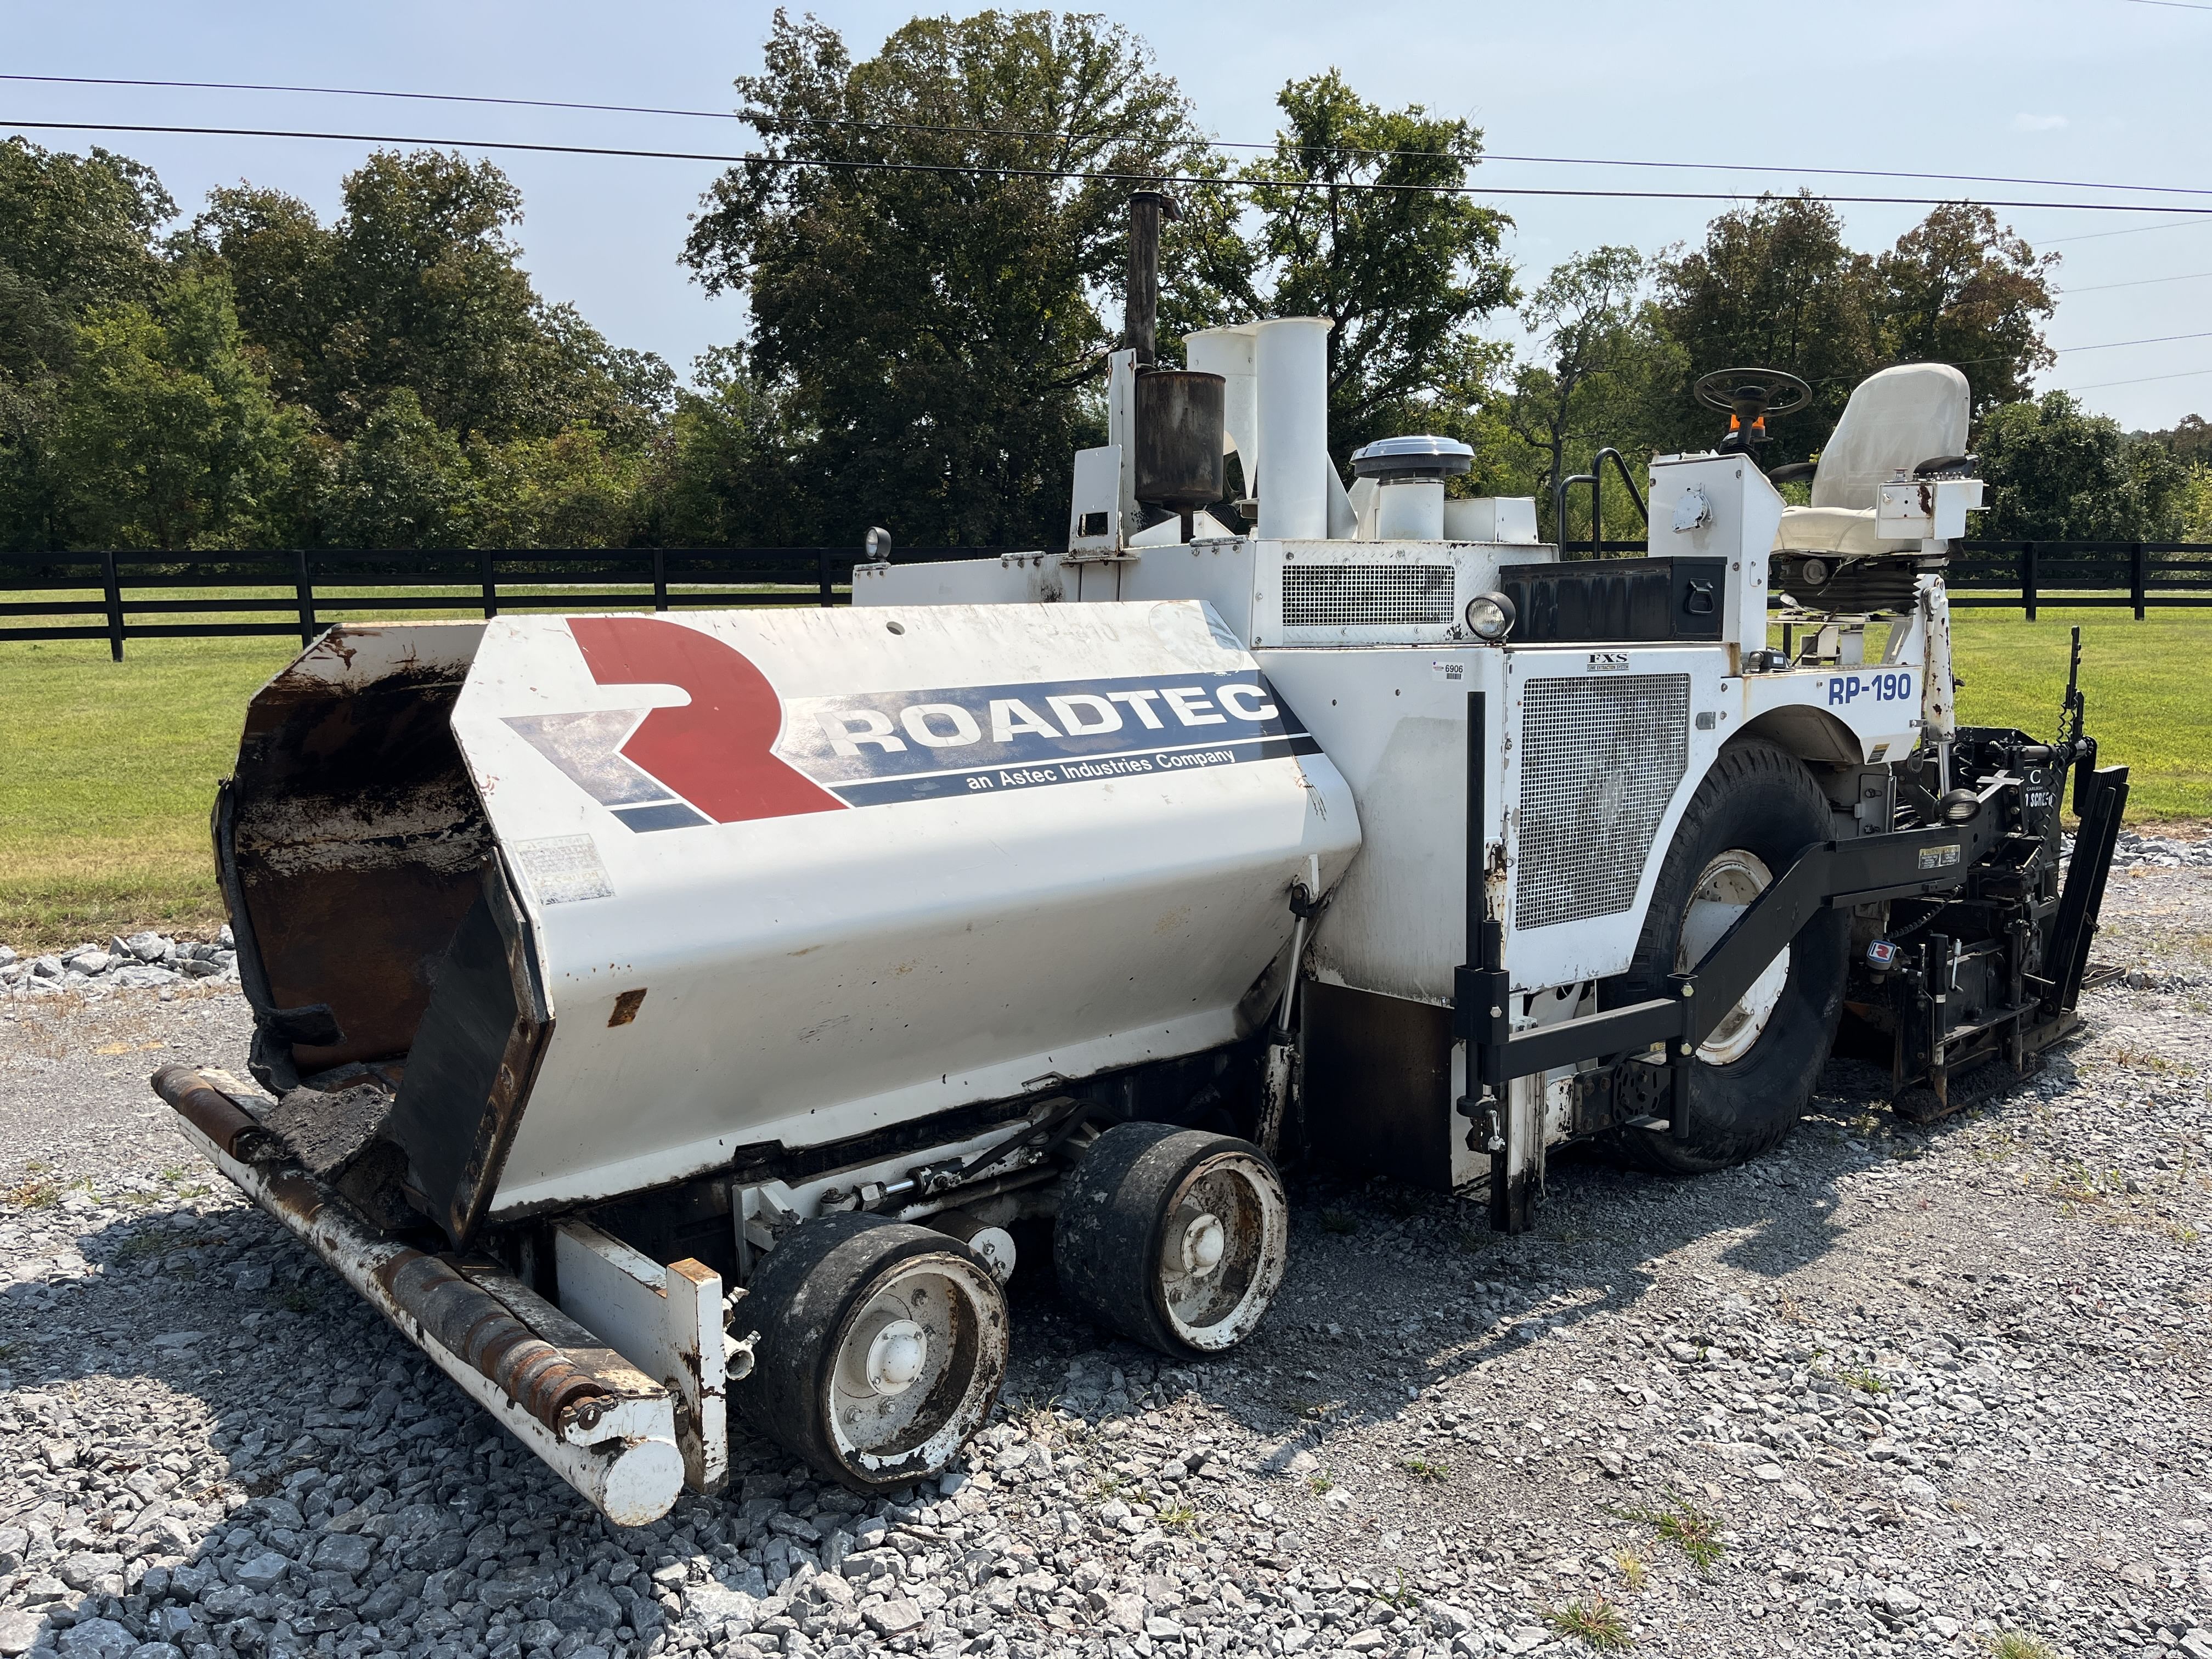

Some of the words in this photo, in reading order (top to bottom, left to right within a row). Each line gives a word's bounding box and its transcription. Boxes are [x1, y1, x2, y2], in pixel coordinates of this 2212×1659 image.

[1445, 664, 1463, 673] 6906
[1589, 653, 1627, 663] FXS
[1829, 674, 1911, 705] RP-190
[815, 684, 1280, 757] ROADTEC
[966, 775, 992, 789] an
[1000, 769, 1057, 786] Astec
[1060, 758, 1153, 779] Industries
[1155, 749, 1236, 768] Company
[2030, 770, 2041, 784] C
